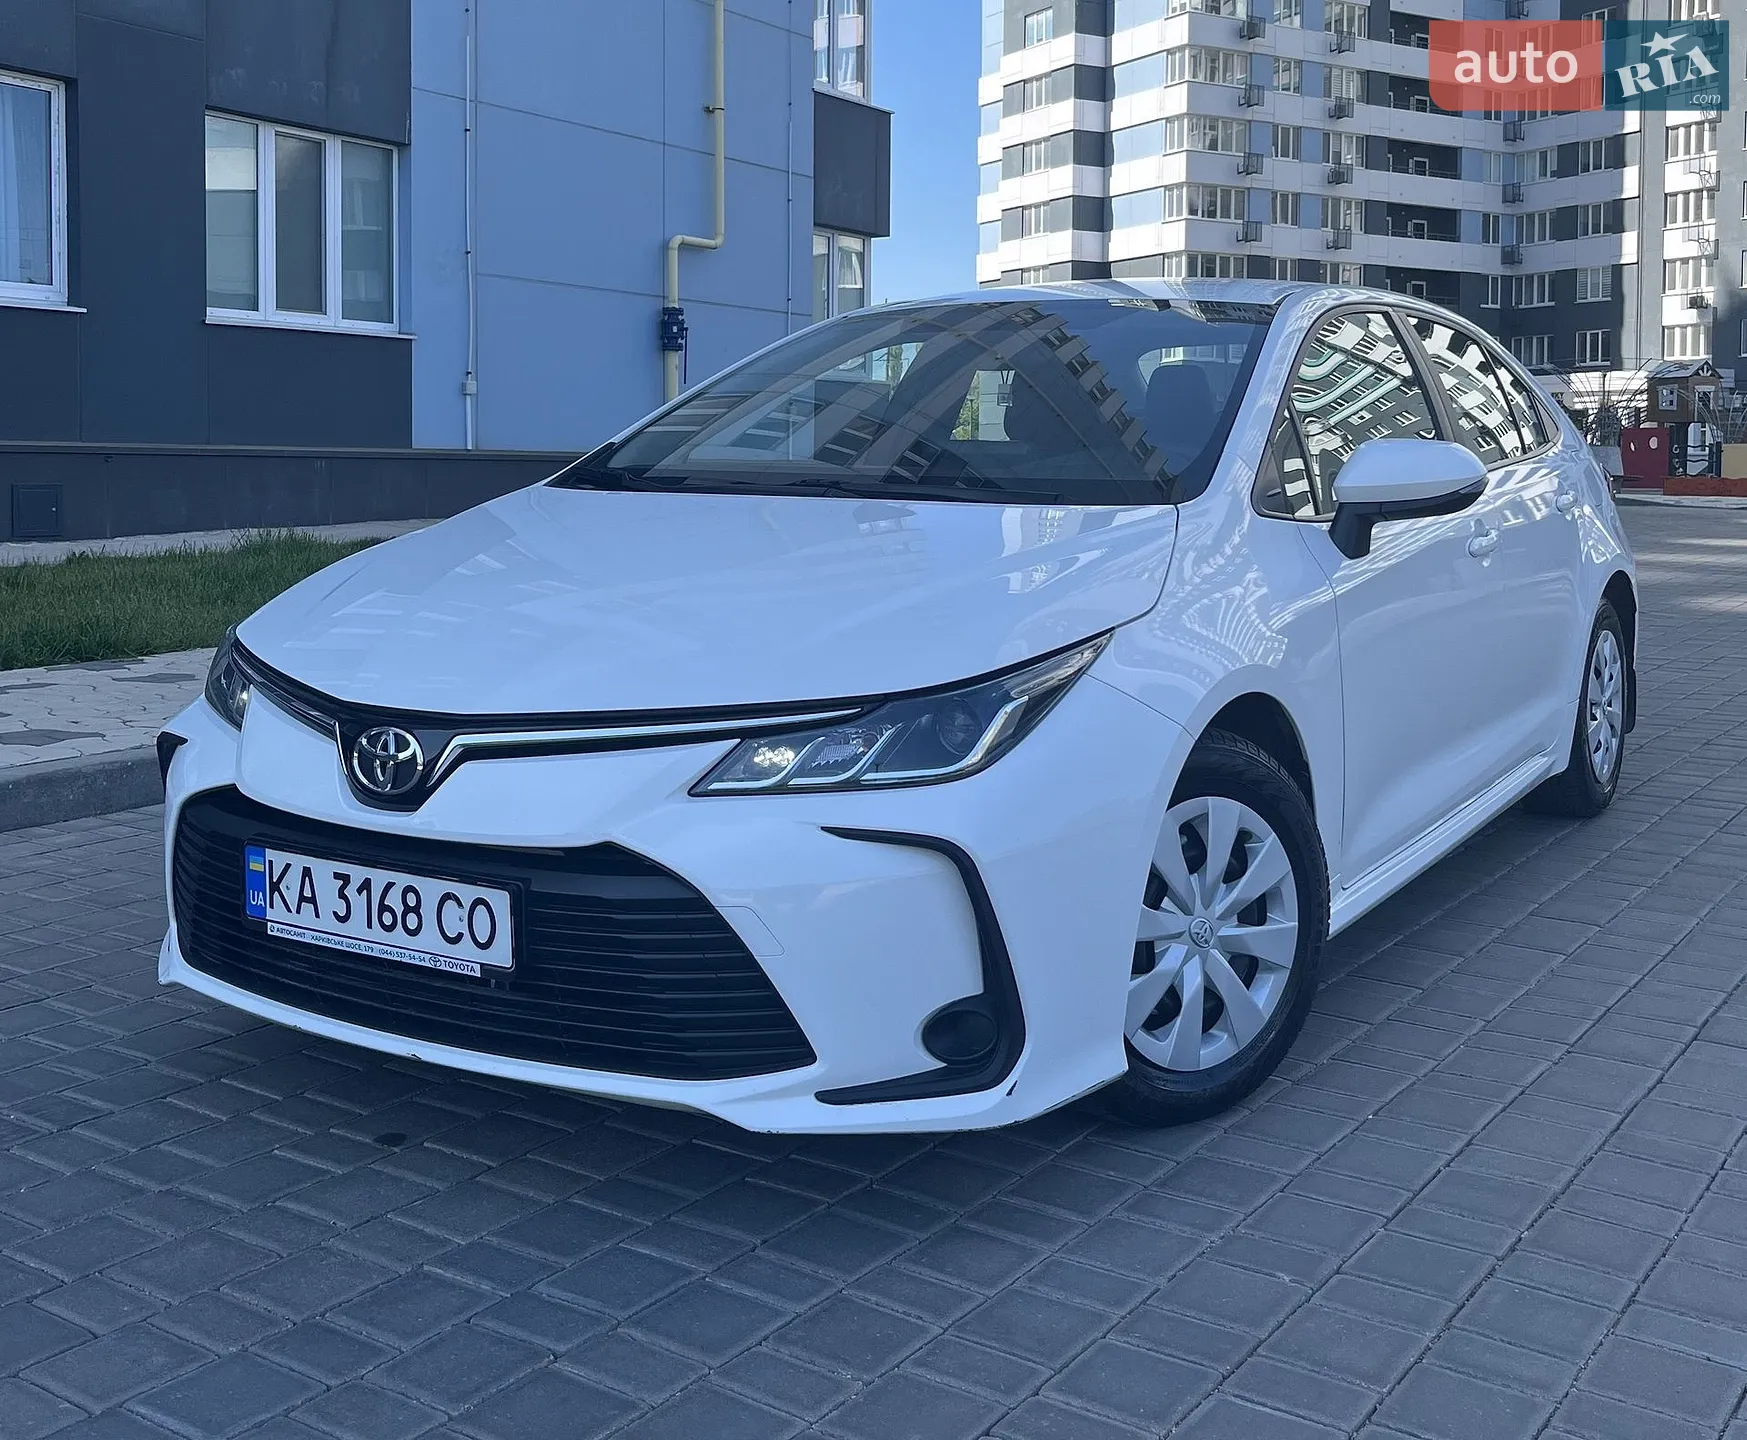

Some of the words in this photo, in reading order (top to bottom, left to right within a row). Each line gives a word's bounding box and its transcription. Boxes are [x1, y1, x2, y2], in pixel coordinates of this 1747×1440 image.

[250, 889, 265, 907] UA
[268, 859, 320, 919] KA
[332, 871, 424, 937] 3168
[436, 891, 497, 950] CO
[443, 959, 476, 974] TOYOTA
